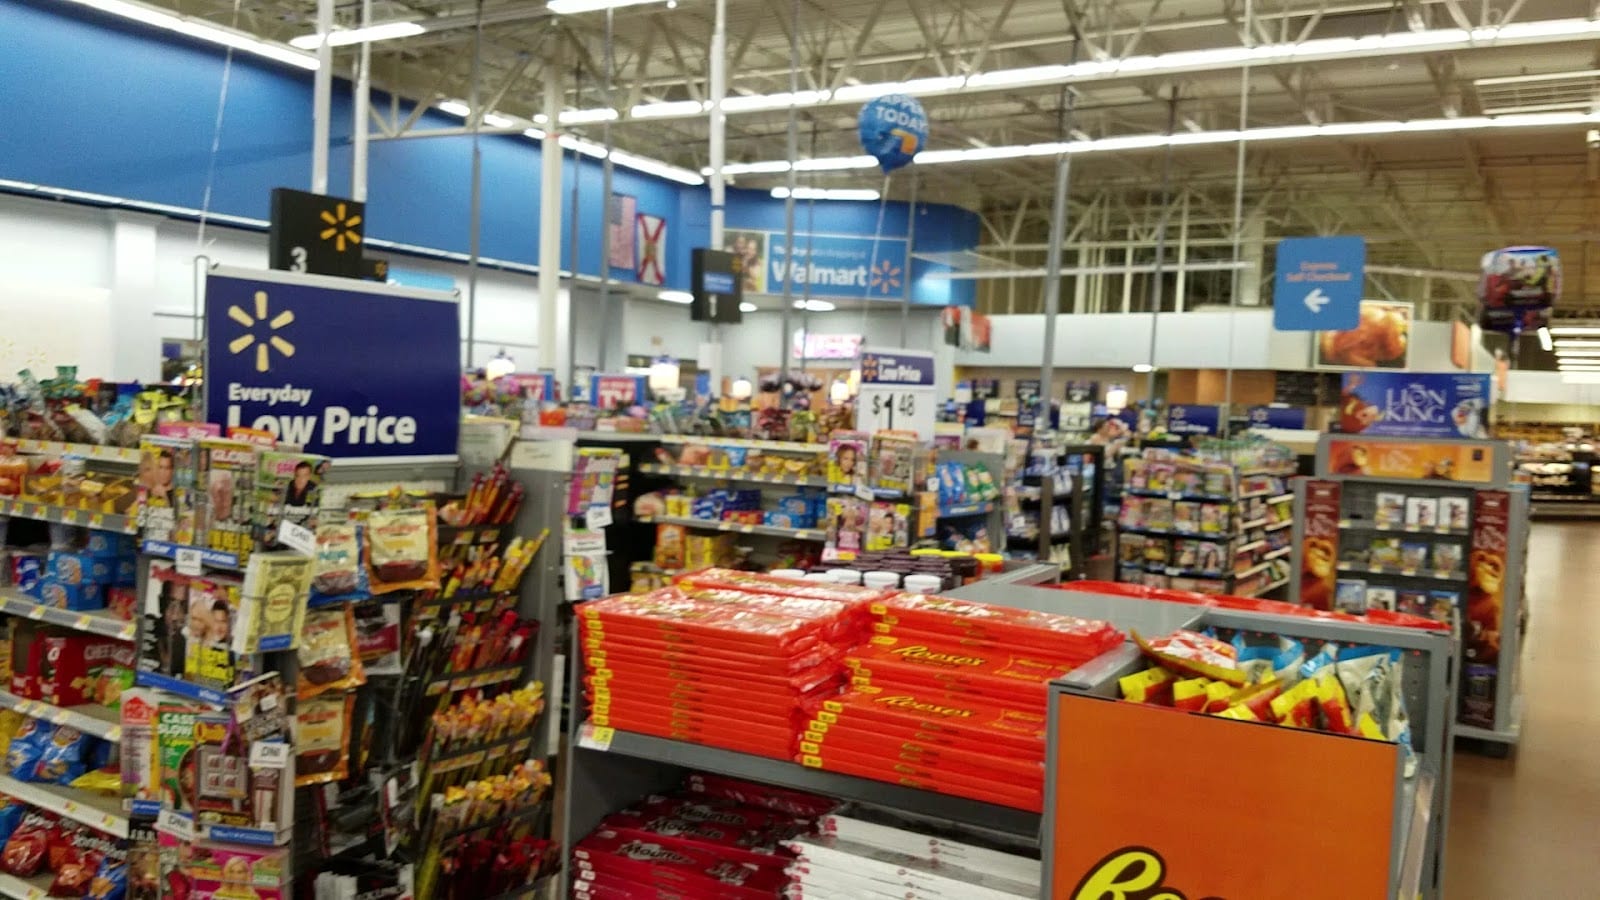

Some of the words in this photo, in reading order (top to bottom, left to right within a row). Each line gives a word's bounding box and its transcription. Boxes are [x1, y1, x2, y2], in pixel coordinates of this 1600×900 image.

[289, 246, 308, 274] 3
[772, 260, 868, 287] Walmart
[228, 382, 313, 406] Everyday
[1385, 387, 1446, 405] LION
[227, 404, 318, 446] Low
[322, 404, 417, 445] Price
[1385, 403, 1446, 423] KING
